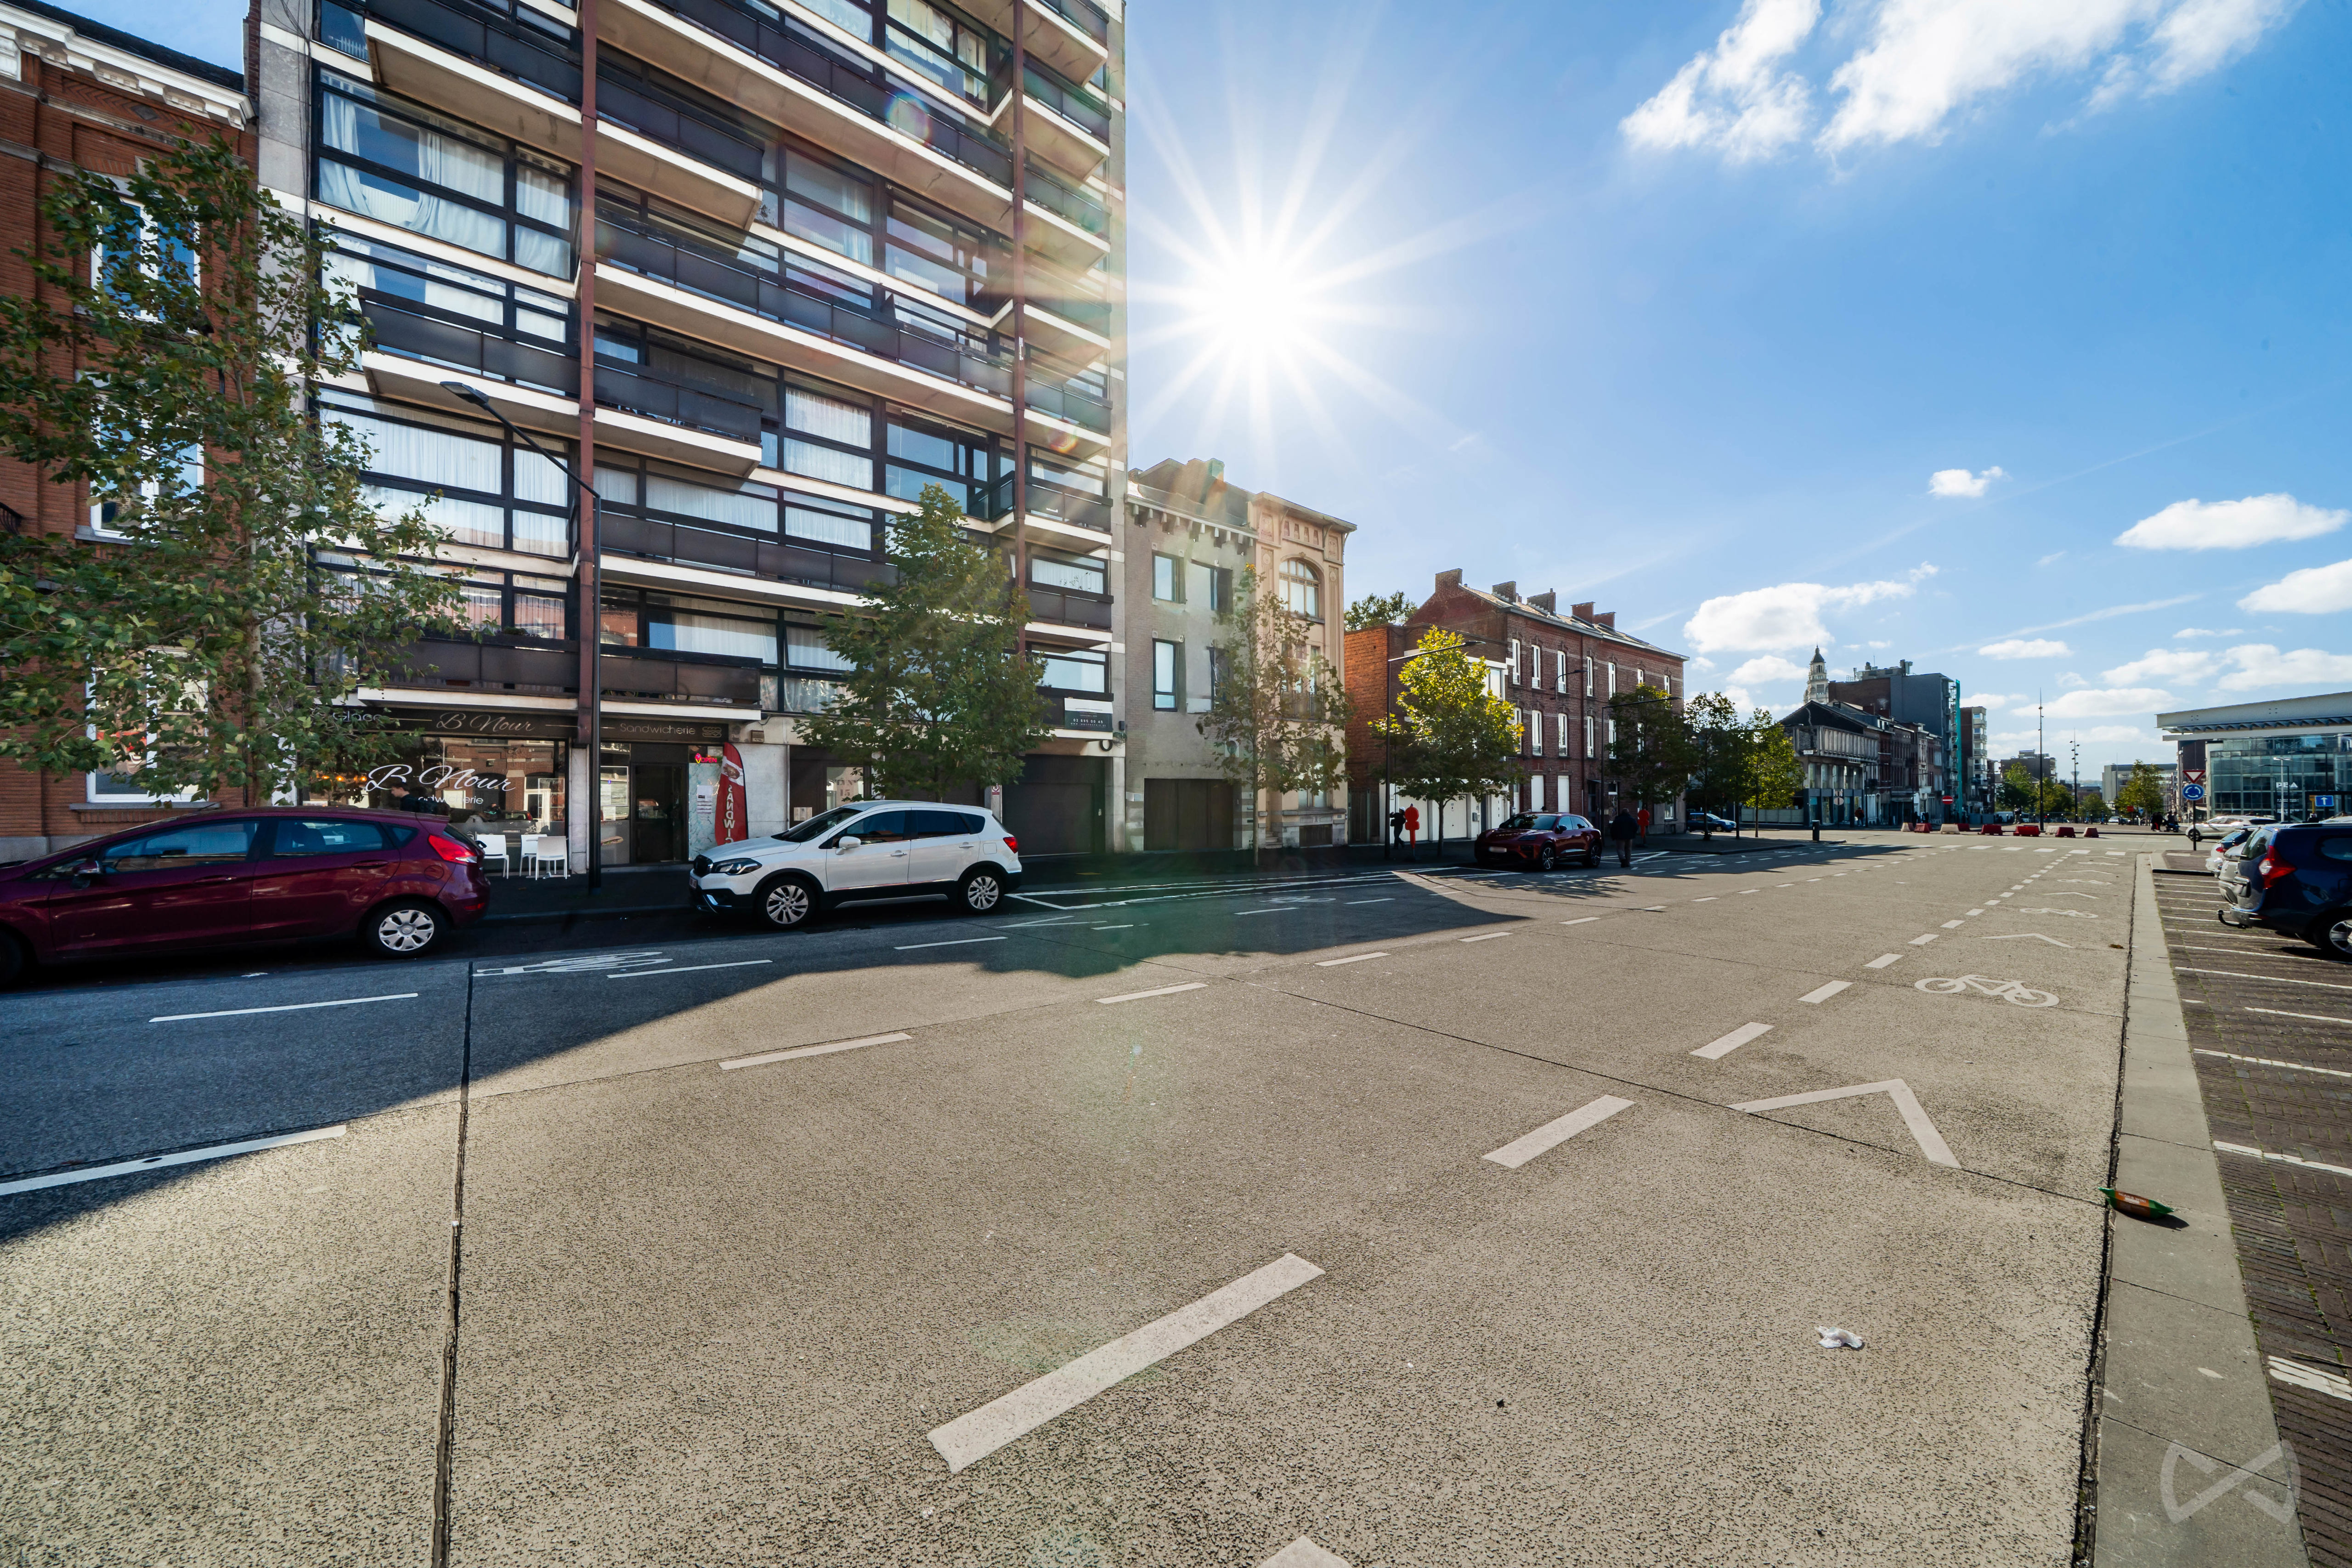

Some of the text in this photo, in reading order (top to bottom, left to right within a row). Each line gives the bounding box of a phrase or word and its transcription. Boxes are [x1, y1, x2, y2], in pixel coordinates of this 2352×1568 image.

[436, 712, 535, 732] B Nour
[620, 723, 696, 735] Sandwicherie
[365, 764, 516, 792] B Nour
